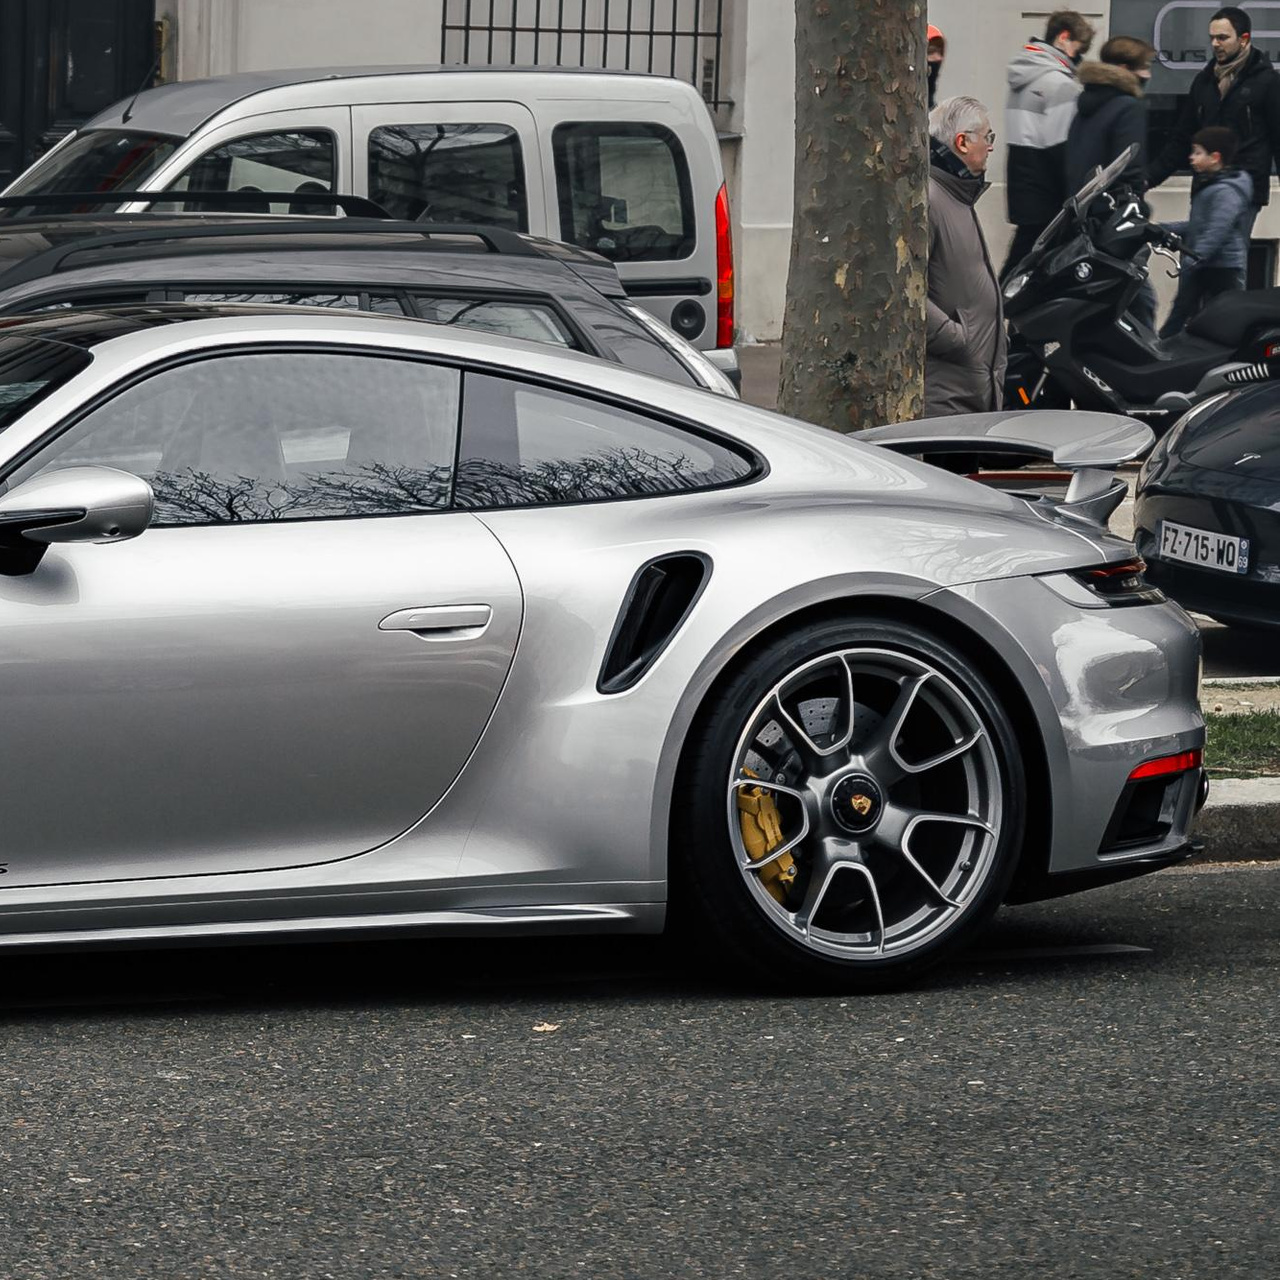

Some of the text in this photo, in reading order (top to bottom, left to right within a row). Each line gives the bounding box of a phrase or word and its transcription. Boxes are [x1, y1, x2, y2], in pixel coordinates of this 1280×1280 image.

[1152, 49, 1207, 63] ours
[1162, 525, 1236, 567] FZ-715-WQ
[1238, 555, 1248, 569] 69
